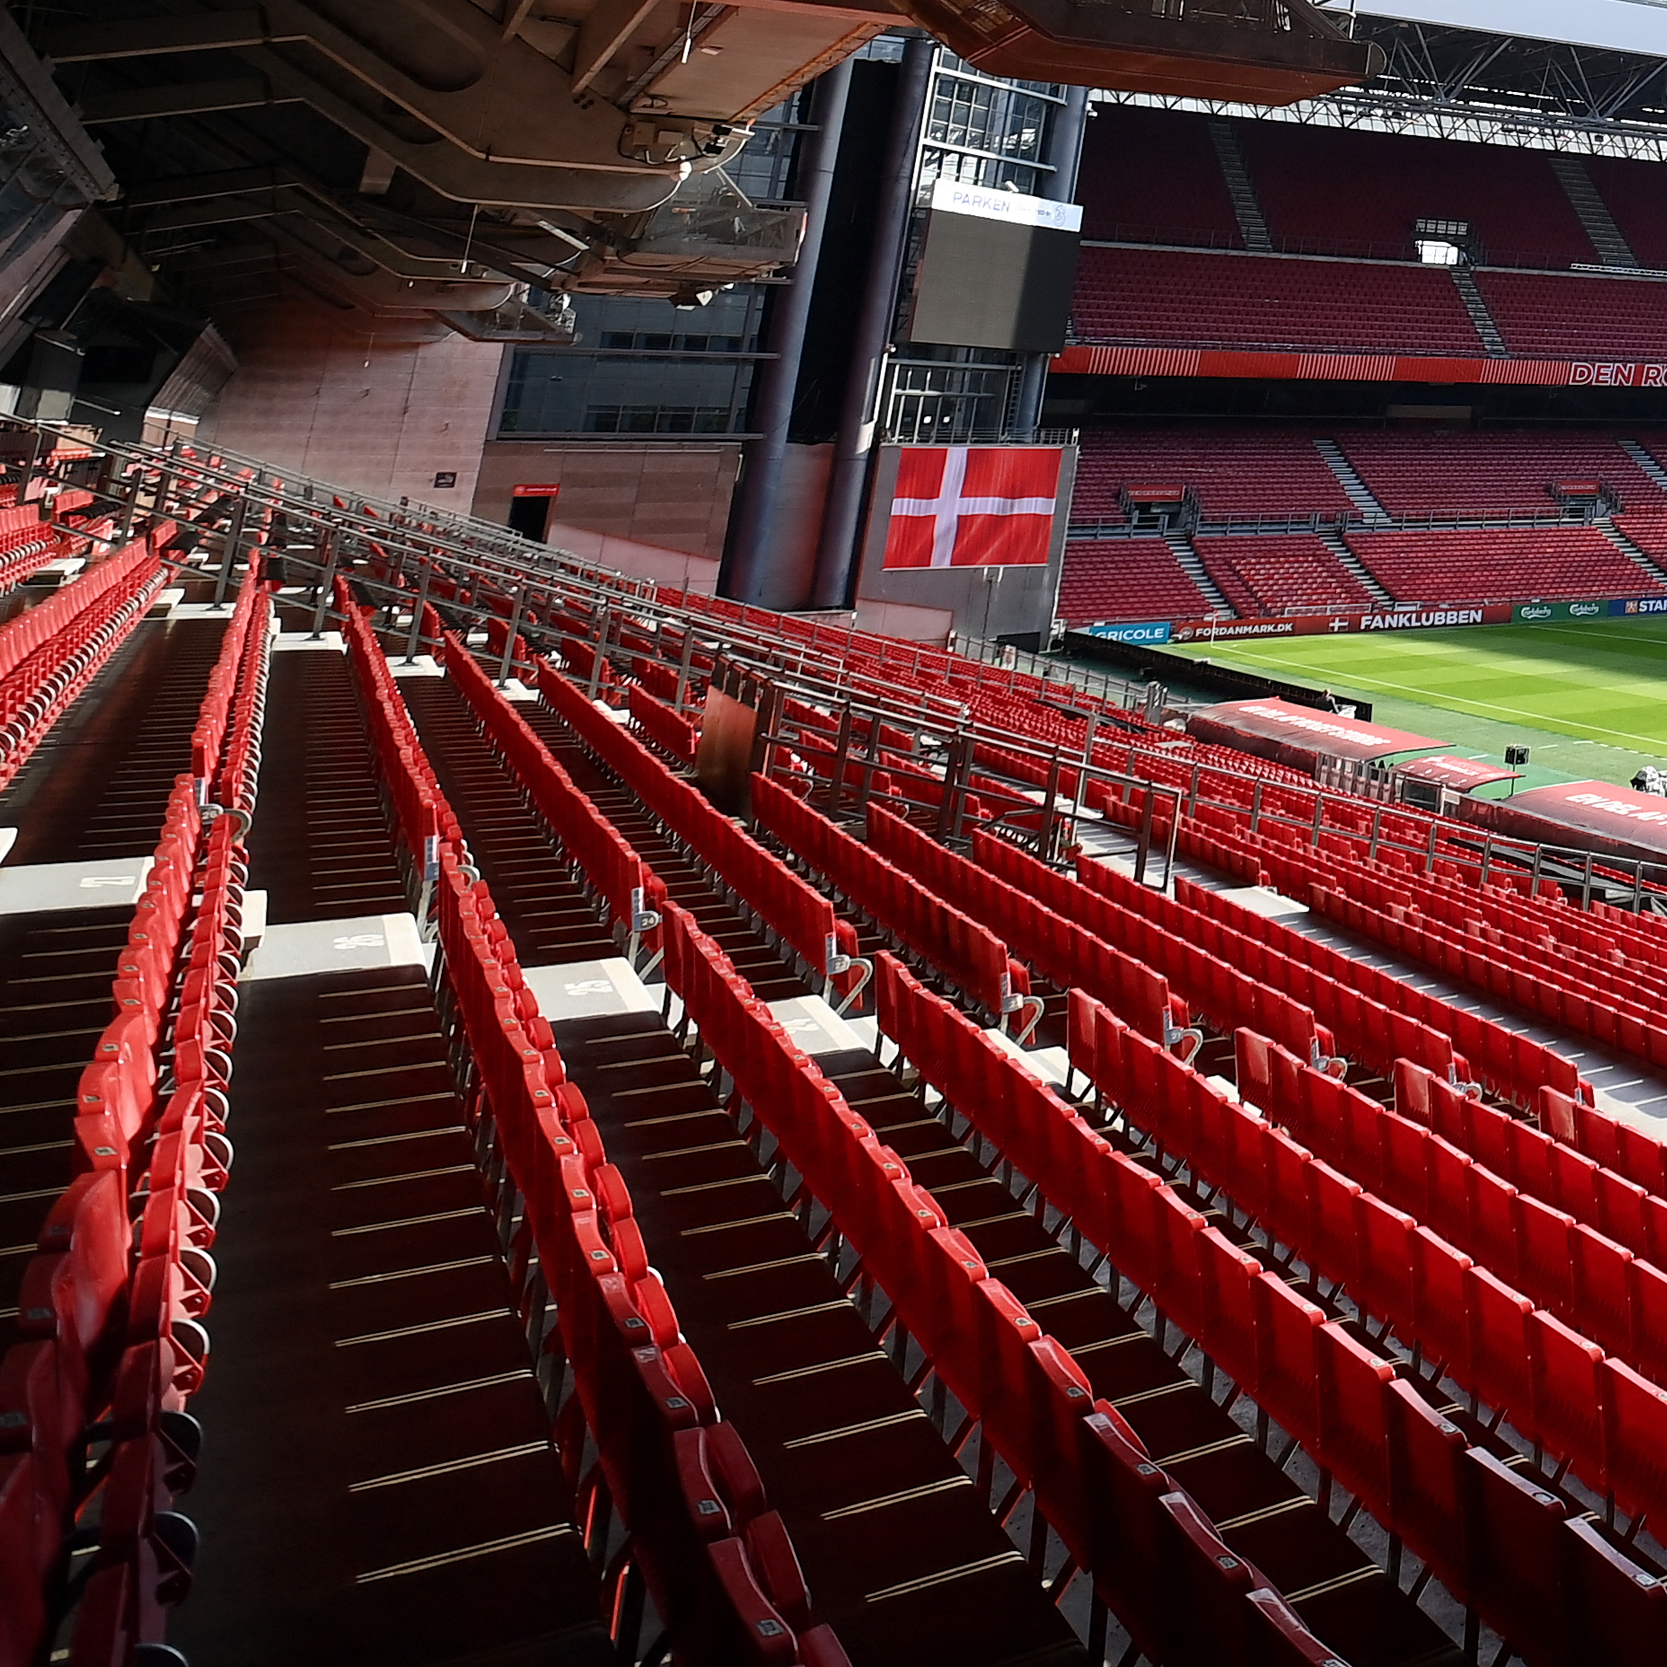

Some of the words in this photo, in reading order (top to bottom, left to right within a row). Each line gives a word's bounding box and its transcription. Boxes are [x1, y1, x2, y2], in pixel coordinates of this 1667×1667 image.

[952, 191, 1010, 213] PARKEN
[1569, 362, 1635, 386] DEN
[1520, 604, 1551, 619] Carlsberg
[1569, 602, 1599, 617] Carlsberg
[1360, 609, 1482, 630] FANKLUBBEN
[1195, 622, 1293, 637] FORDANMARK.DK
